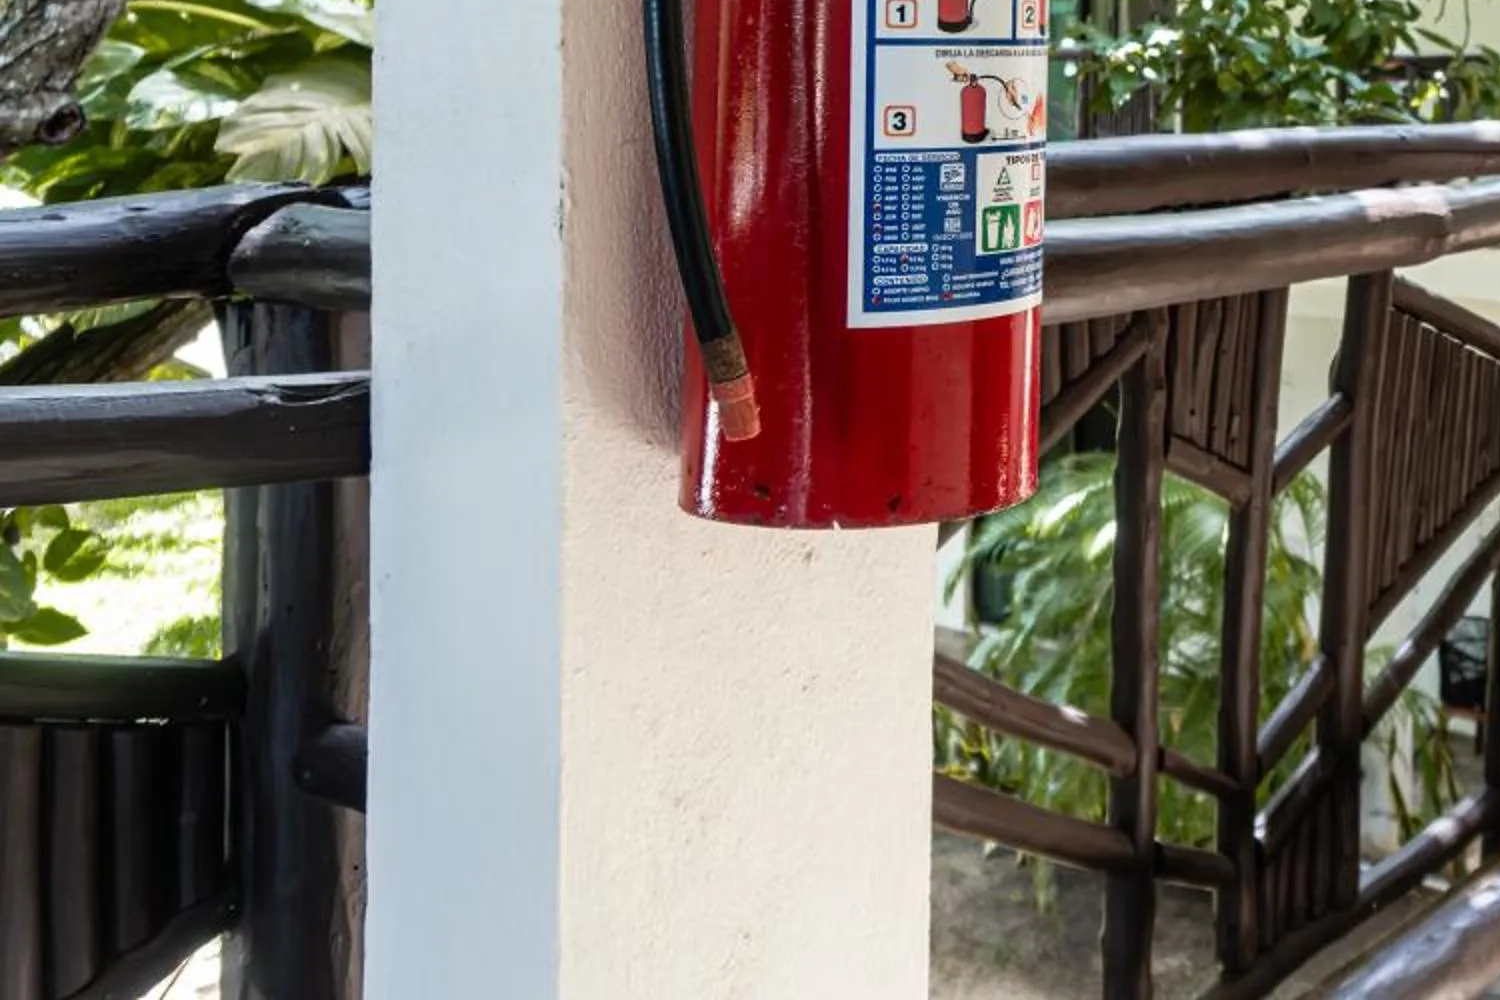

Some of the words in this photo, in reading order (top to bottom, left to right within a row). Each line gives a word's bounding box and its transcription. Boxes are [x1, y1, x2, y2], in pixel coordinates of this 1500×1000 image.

[895, 4, 906, 23] 1
[1025, 6, 1035, 24] 2
[892, 111, 907, 131] 3
